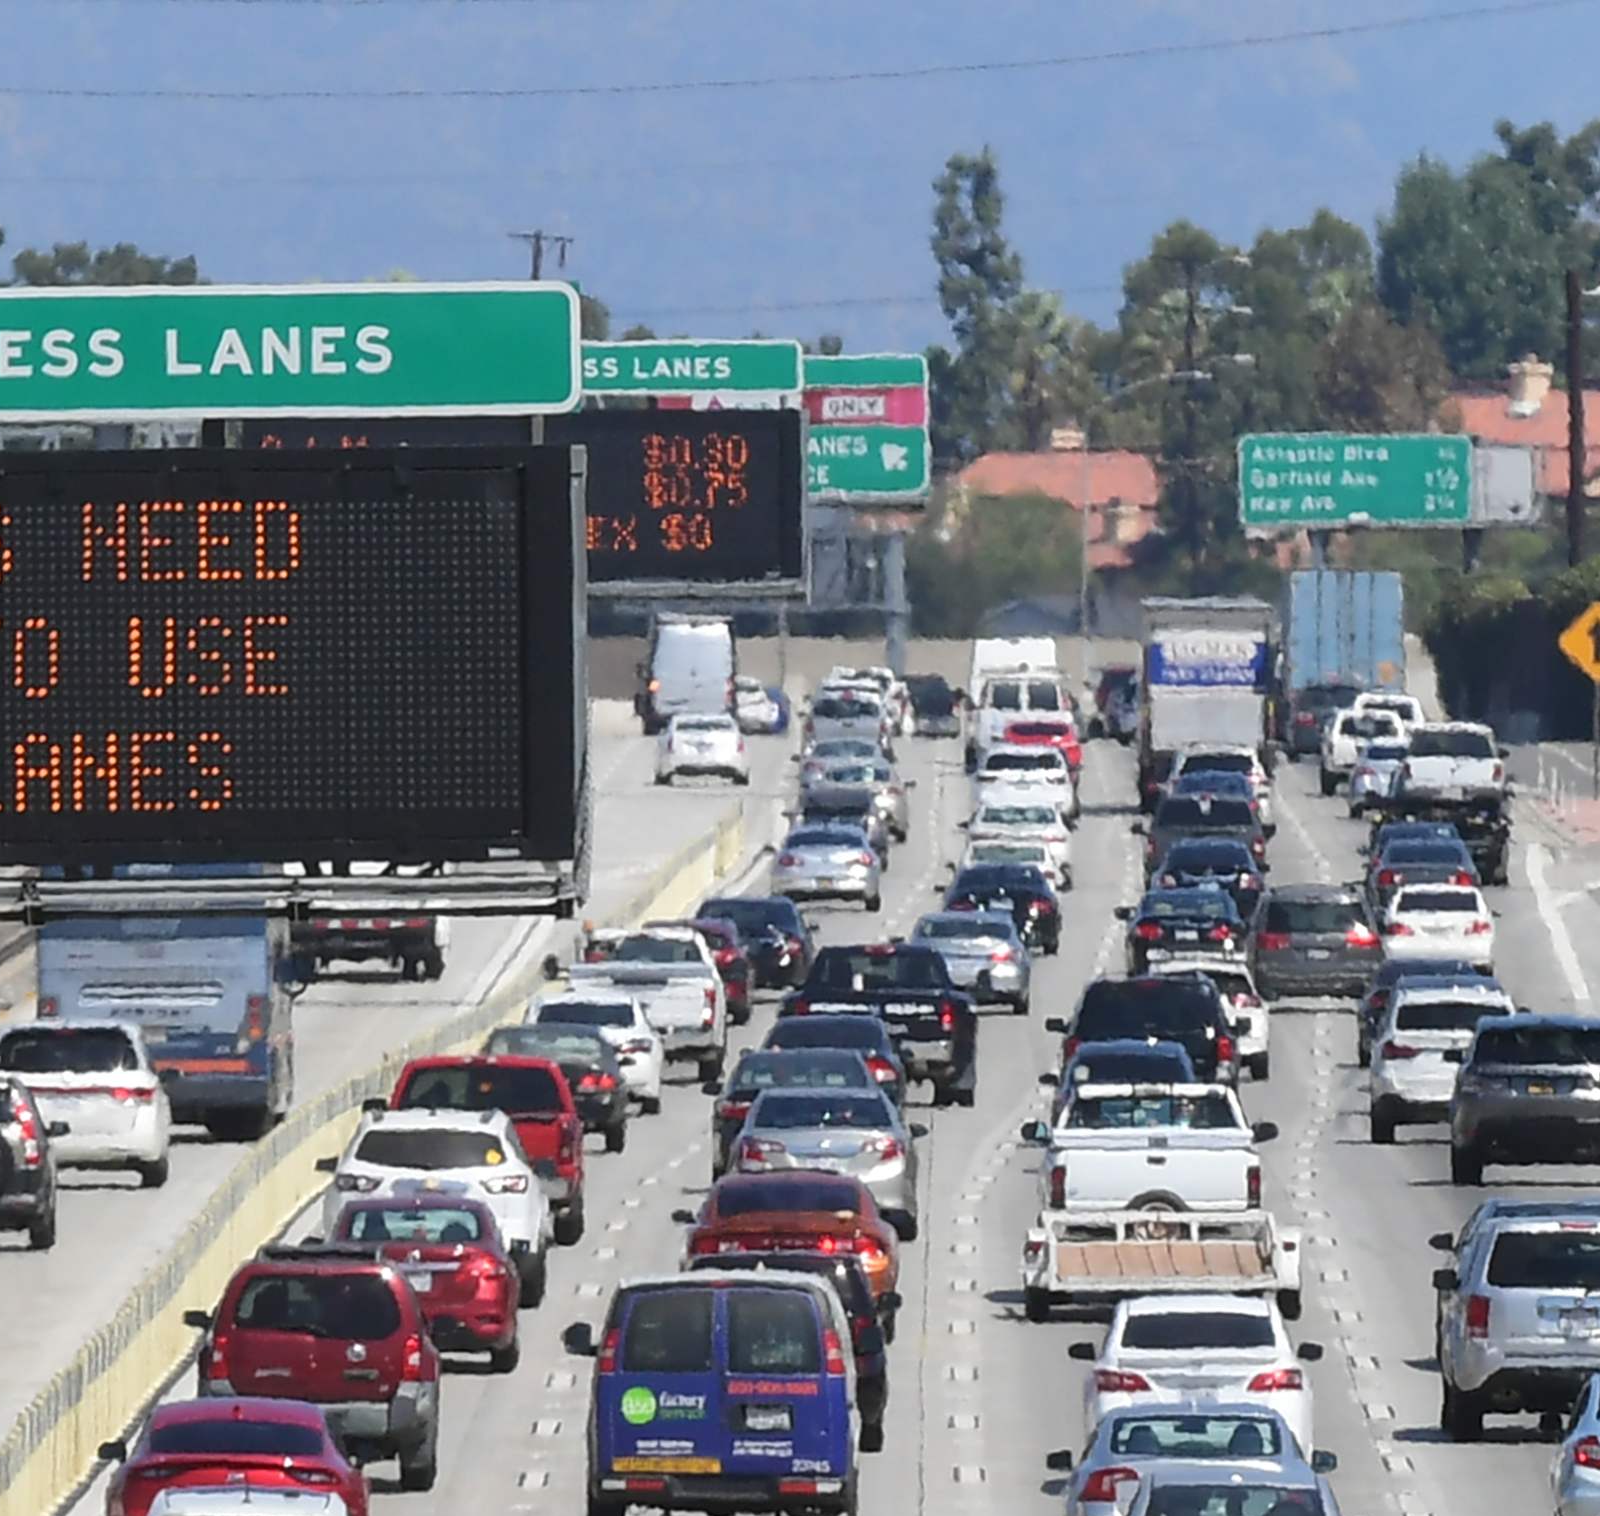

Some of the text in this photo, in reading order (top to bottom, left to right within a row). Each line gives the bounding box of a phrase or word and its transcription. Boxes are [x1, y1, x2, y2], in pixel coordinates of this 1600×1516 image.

[164, 325, 394, 376] LANES
[634, 356, 732, 379] LANES
[828, 397, 879, 415] ONLY
[807, 435, 868, 456] ANES
[81, 500, 301, 583] NEED
[127, 614, 290, 698] USE
